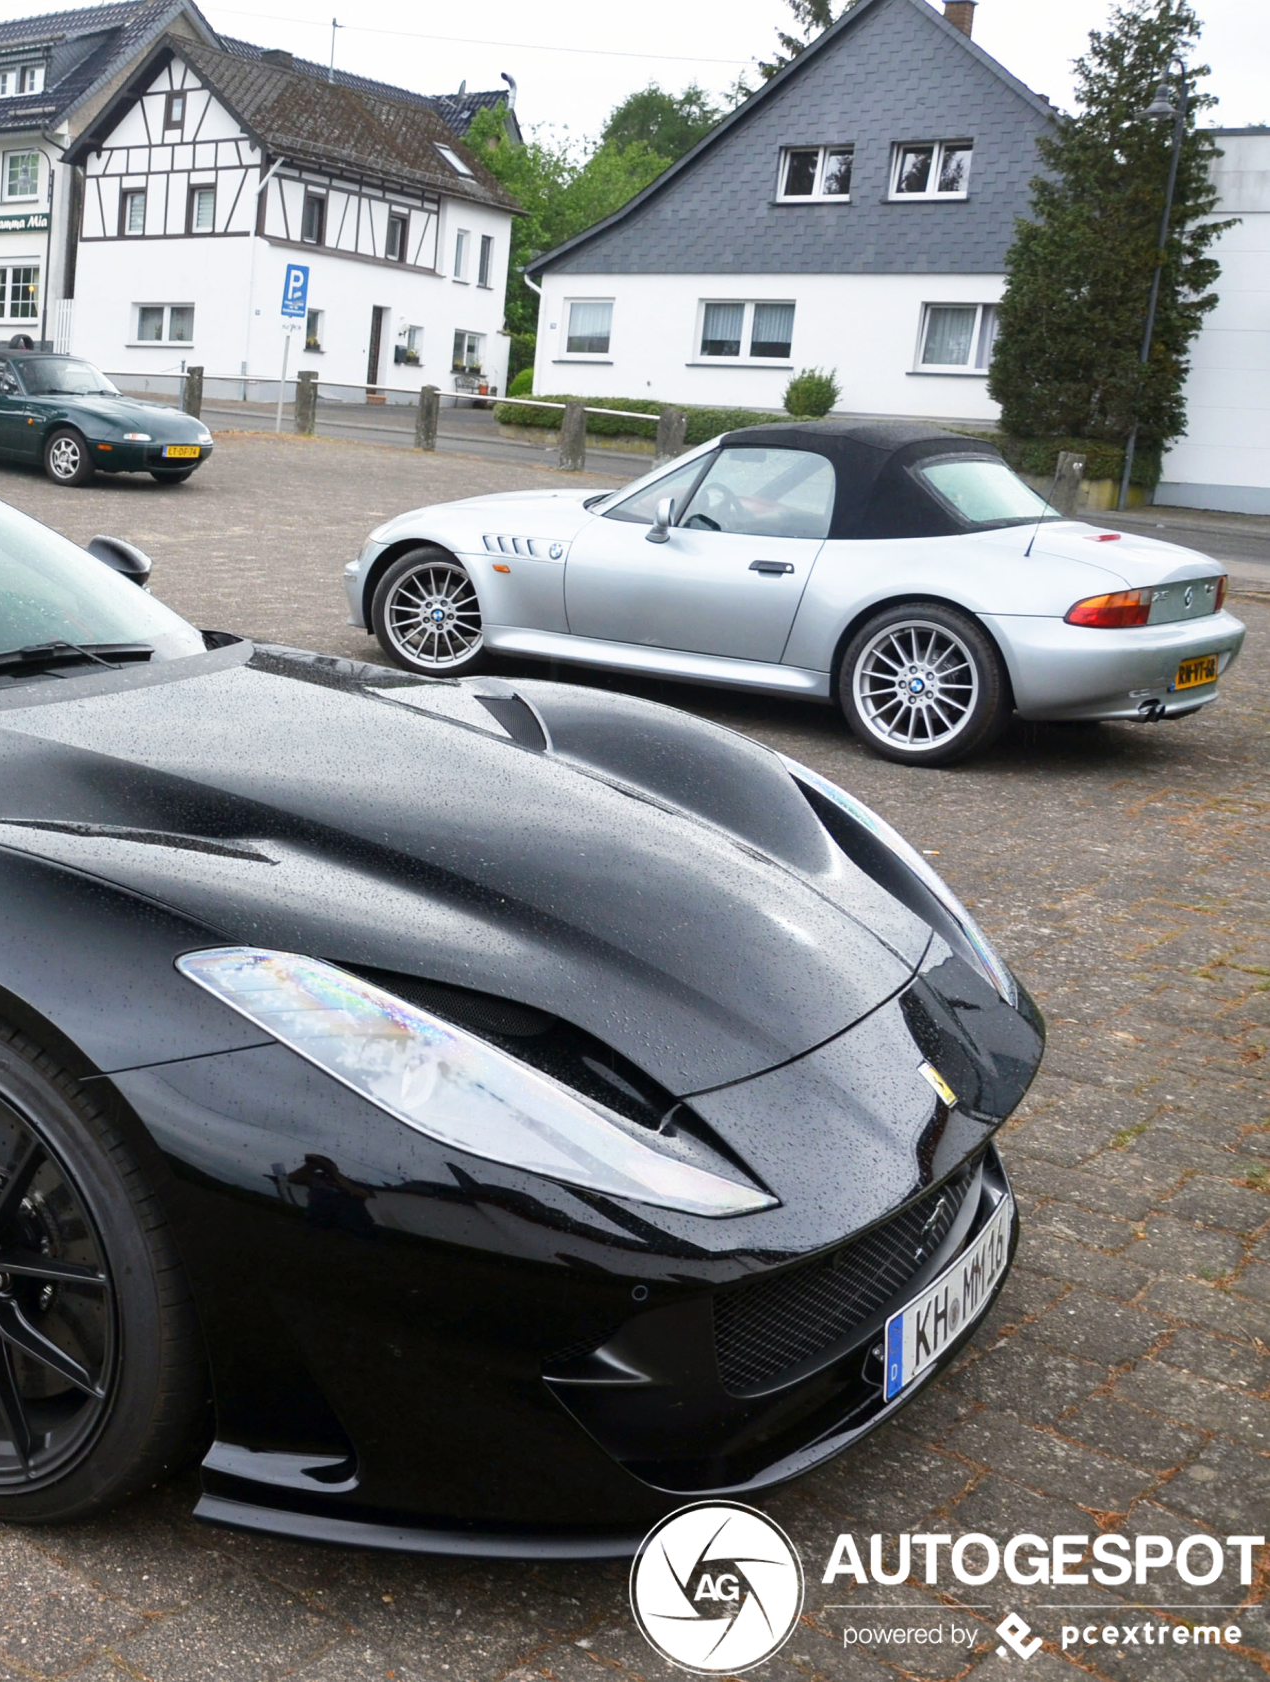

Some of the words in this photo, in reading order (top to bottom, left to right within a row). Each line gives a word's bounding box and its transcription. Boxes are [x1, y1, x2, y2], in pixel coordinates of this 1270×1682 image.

[27, 215, 47, 228] Mia
[288, 269, 304, 299] P
[915, 1285, 948, 1366] KH
[891, 1363, 898, 1381] D
